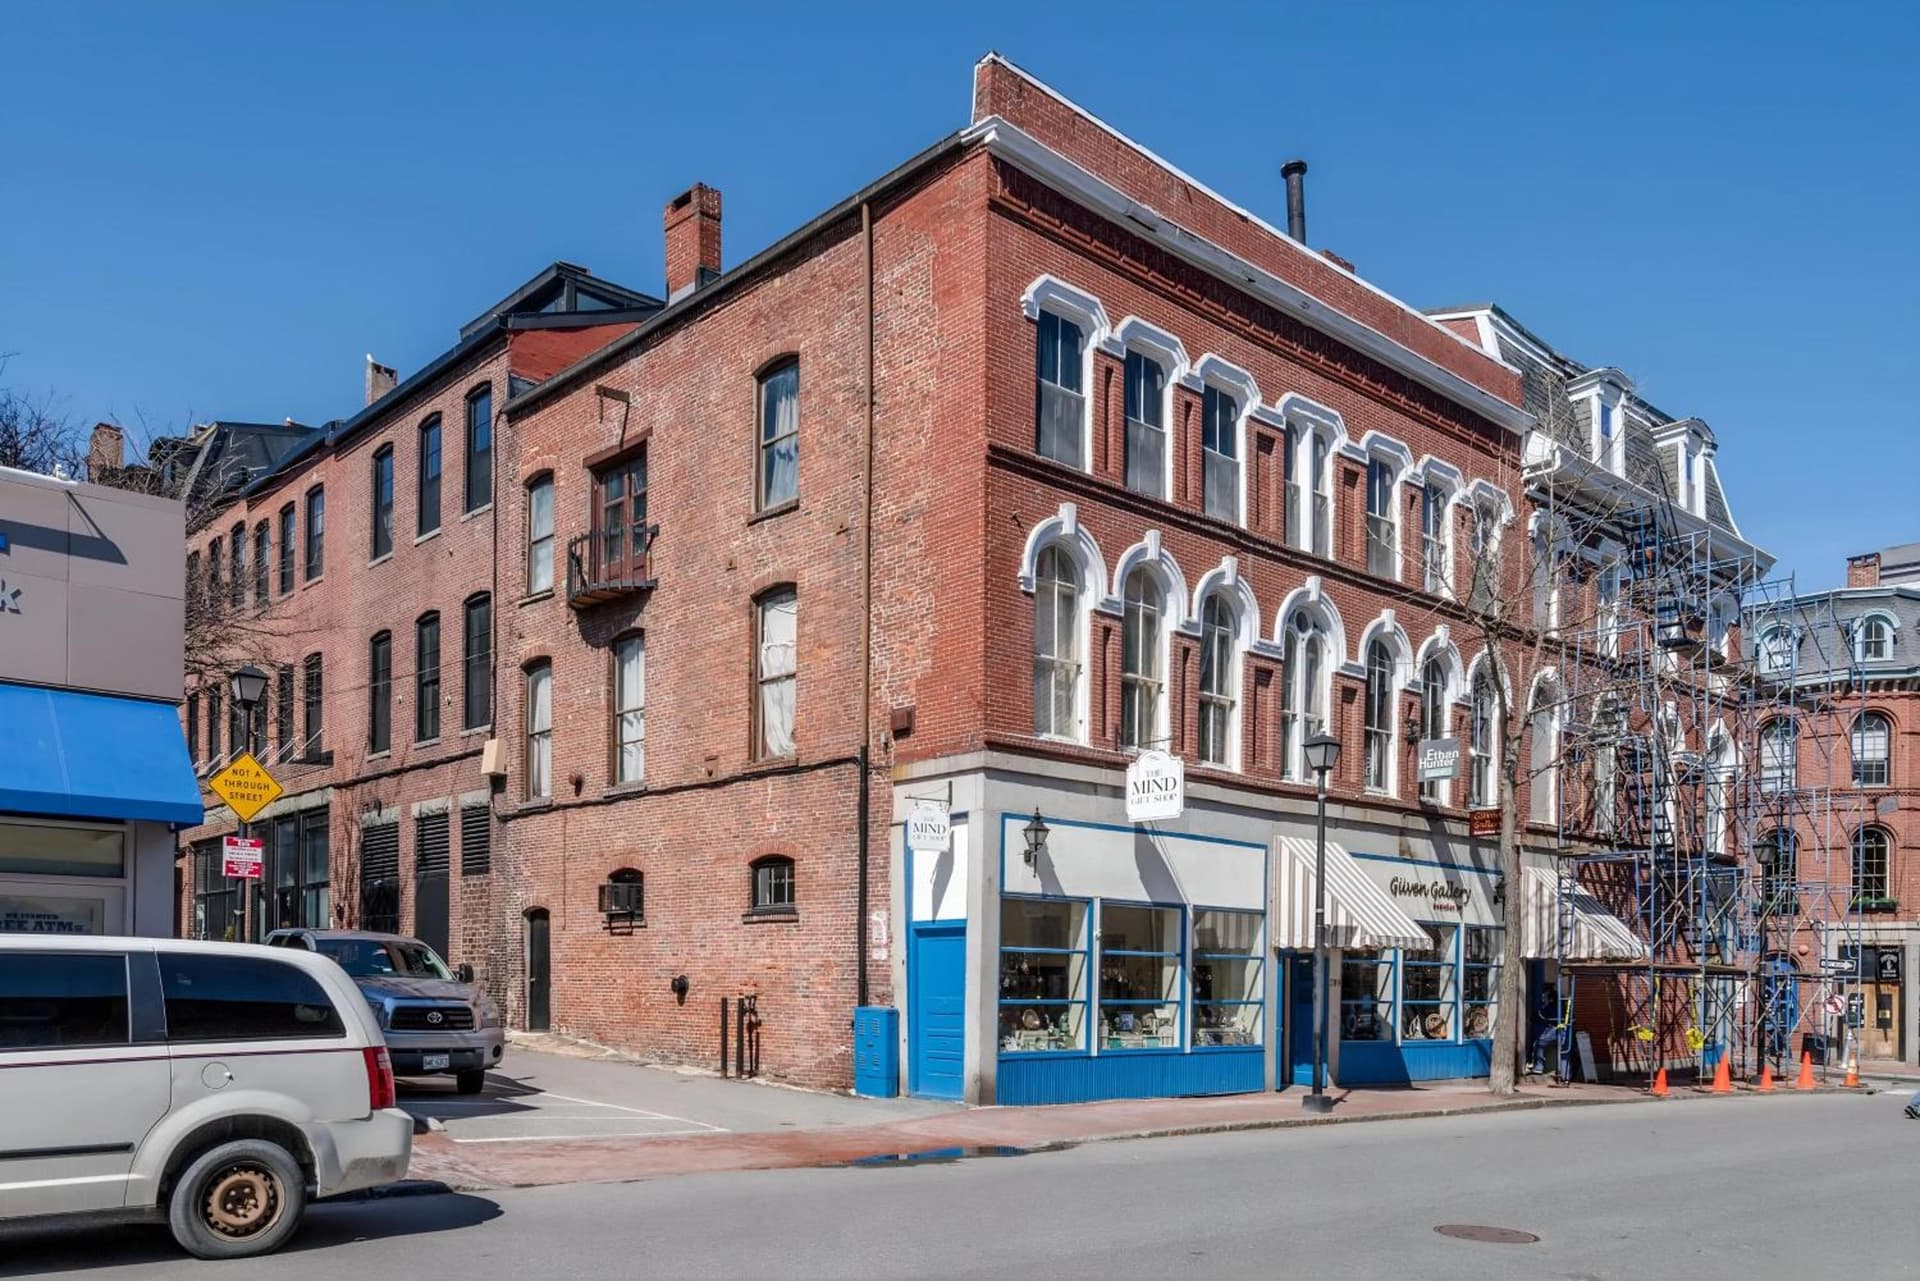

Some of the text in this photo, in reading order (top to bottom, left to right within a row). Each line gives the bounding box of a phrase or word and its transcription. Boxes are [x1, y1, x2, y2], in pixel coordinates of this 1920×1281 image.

[1426, 748, 1459, 760] Ethan
[1418, 757, 1456, 769] Hunter
[231, 768, 249, 777] NOT
[224, 779, 270, 791] THROUGH
[1132, 777, 1177, 795] MIND
[229, 791, 263, 801] STREET
[912, 822, 946, 834] MIND
[1430, 881, 1472, 905] Gallery
